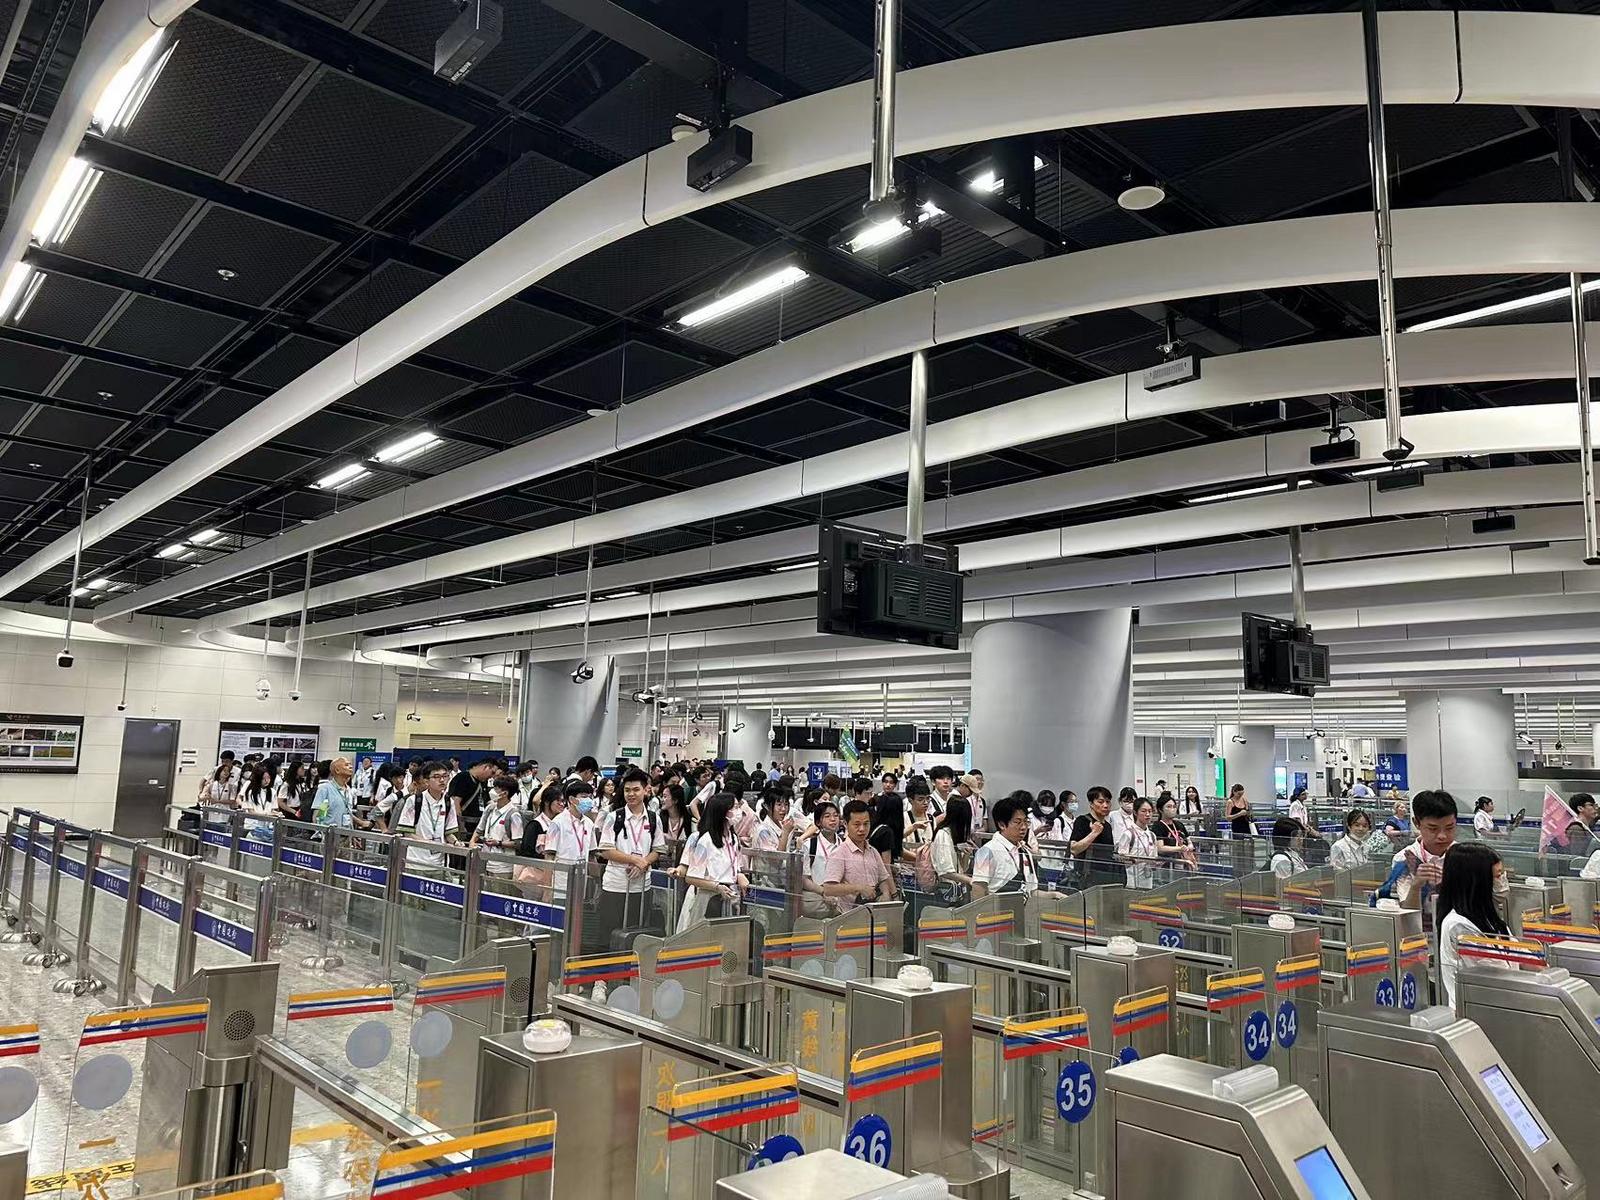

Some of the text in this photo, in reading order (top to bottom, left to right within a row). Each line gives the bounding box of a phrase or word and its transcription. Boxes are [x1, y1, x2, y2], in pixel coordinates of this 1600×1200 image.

[1403, 982, 1415, 1006] 33
[1247, 1020, 1269, 1051] 34
[1278, 1010, 1297, 1039] 34
[1061, 1072, 1092, 1111] 35
[850, 1129, 888, 1168] 36
